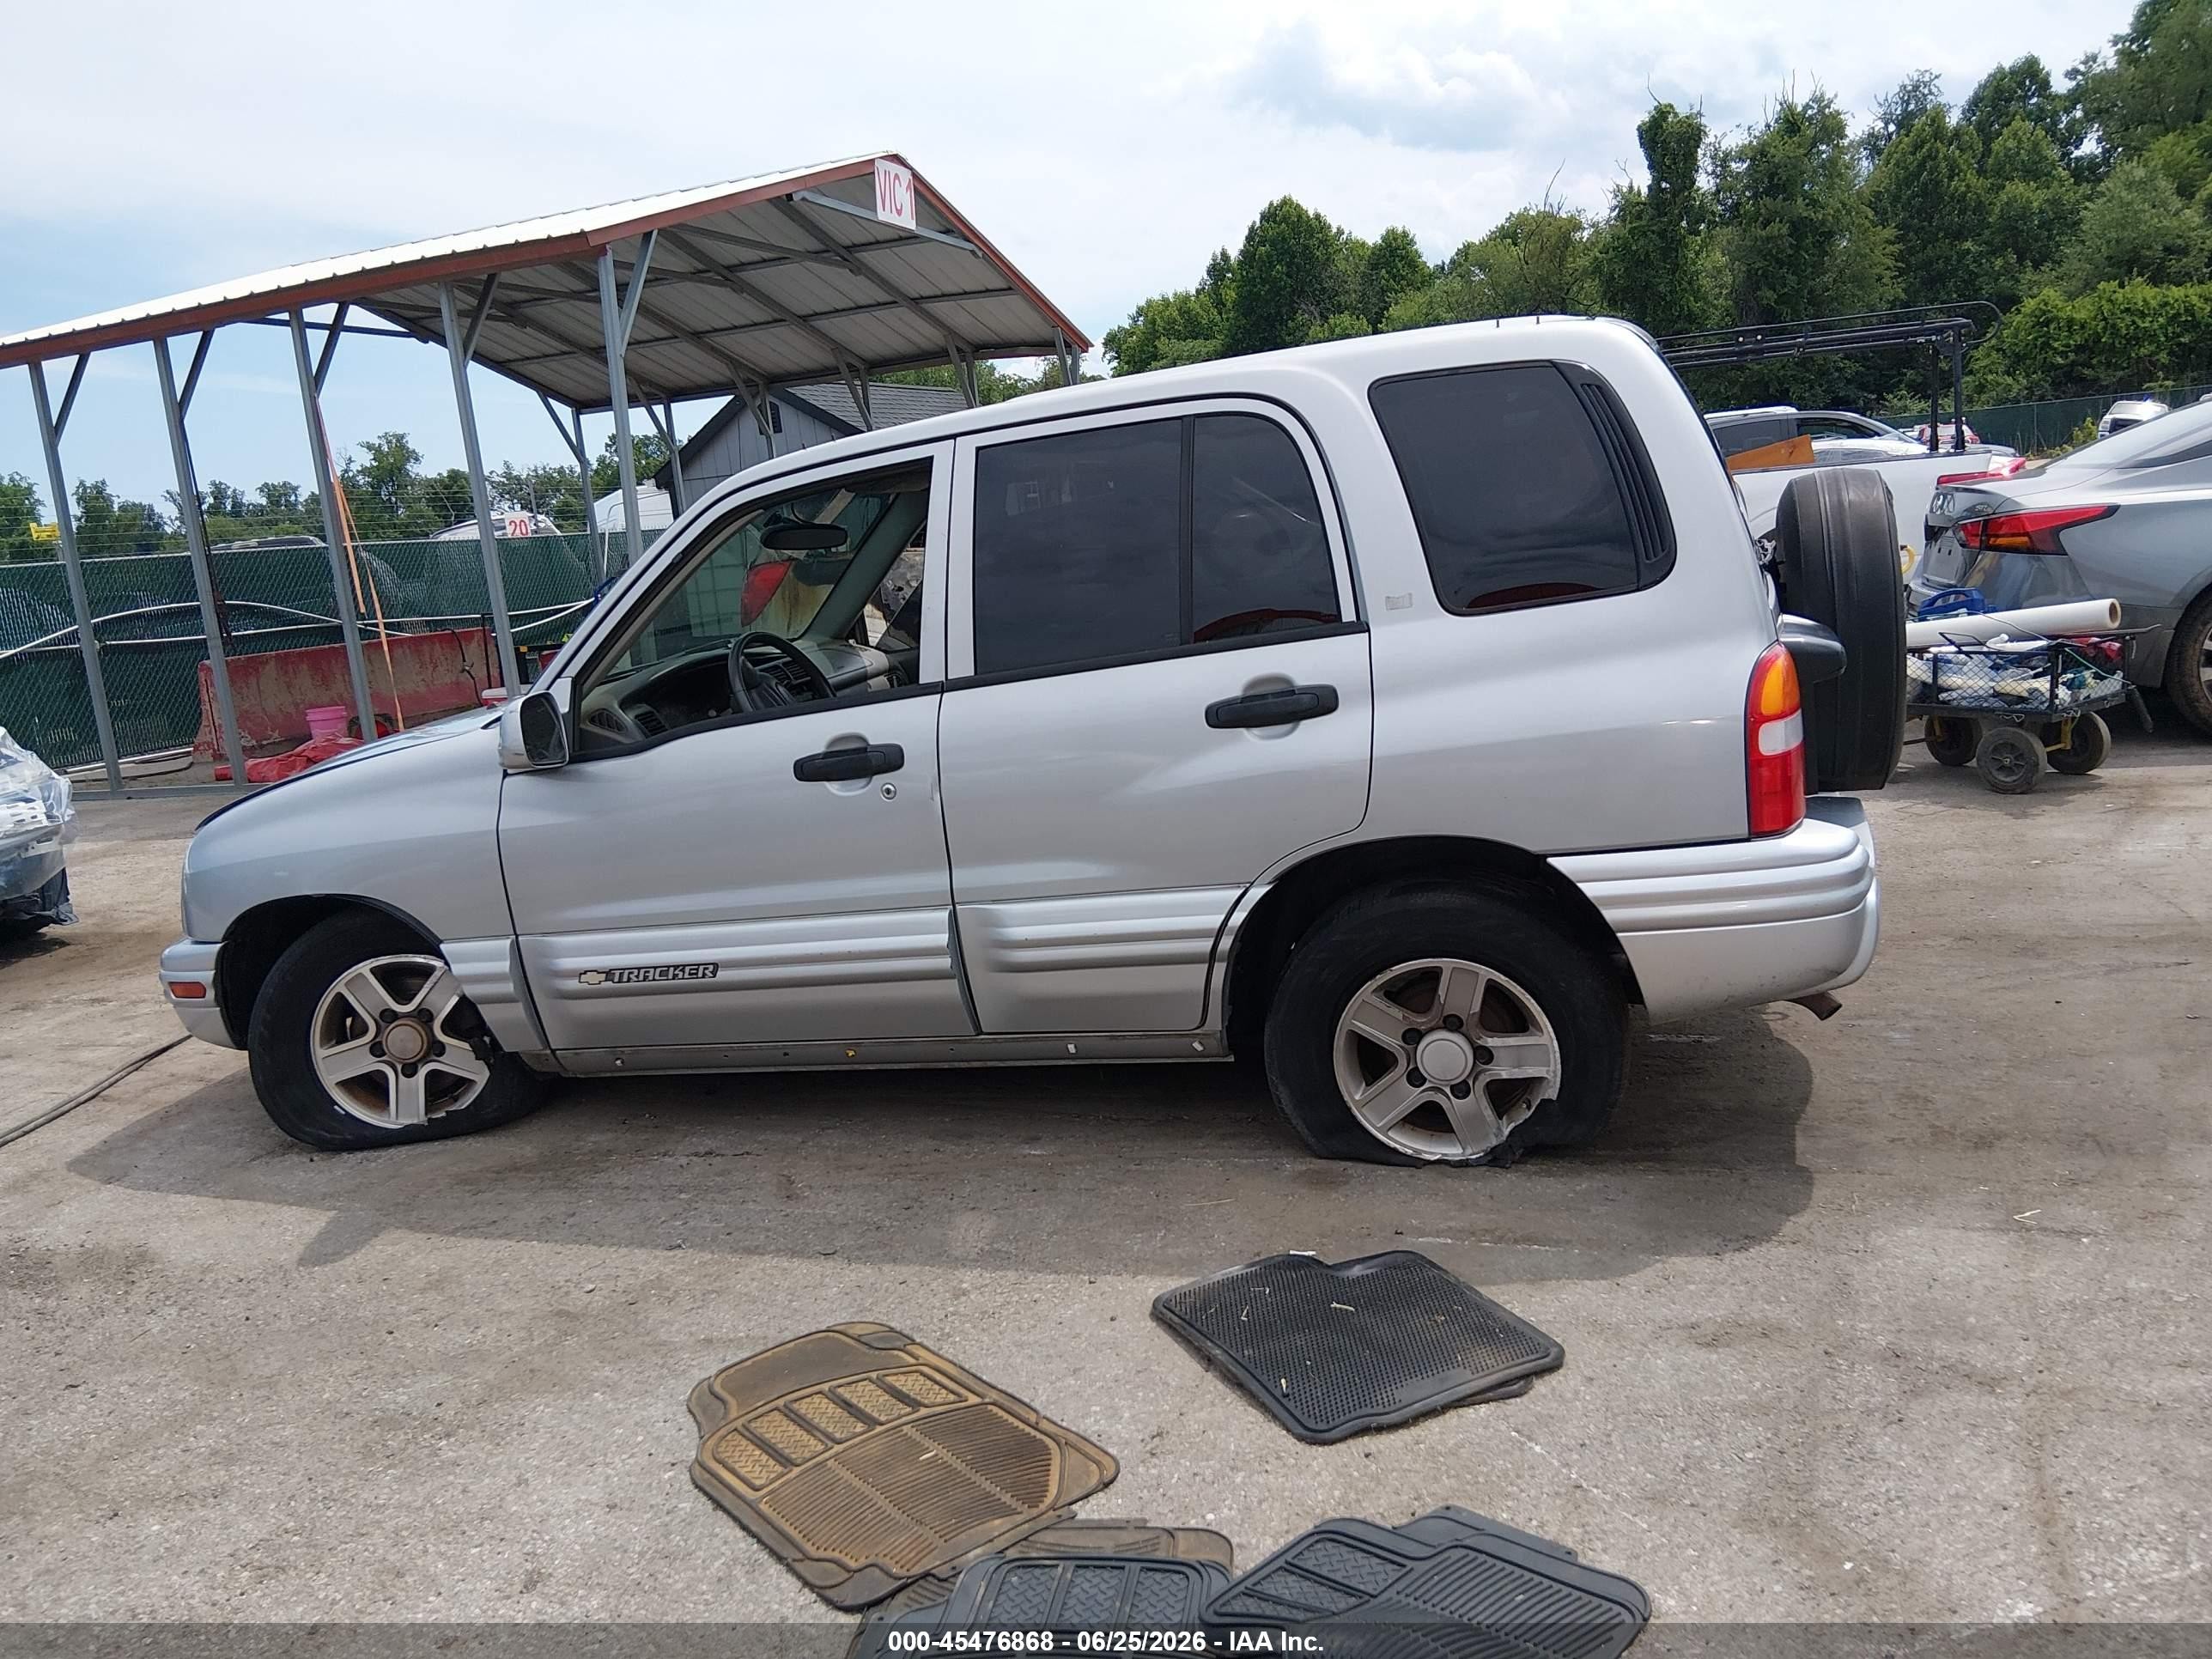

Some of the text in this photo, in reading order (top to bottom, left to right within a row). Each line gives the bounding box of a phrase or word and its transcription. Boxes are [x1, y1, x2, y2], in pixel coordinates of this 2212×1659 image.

[876, 166, 915, 220] VIC 1
[508, 519, 529, 537] 20
[610, 964, 714, 982] TRACKER
